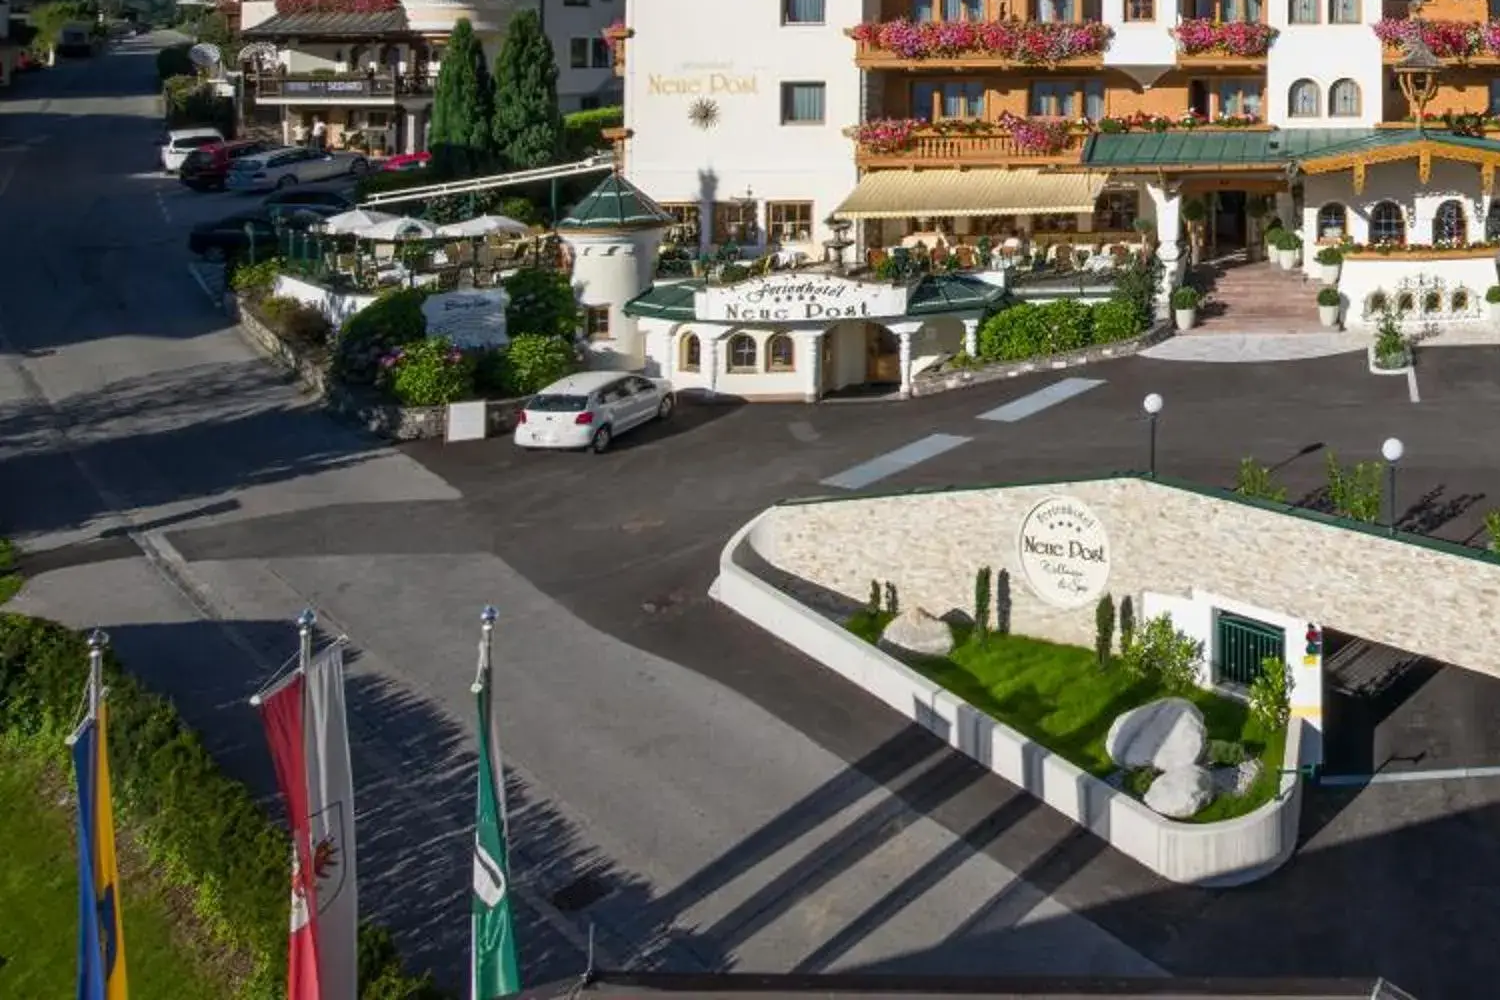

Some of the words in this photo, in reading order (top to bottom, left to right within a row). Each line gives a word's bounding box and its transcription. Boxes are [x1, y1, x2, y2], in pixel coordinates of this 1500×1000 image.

[726, 303, 789, 319] Neue
[805, 301, 870, 319] Post
[1024, 535, 1064, 557] Neue
[1069, 540, 1106, 563] Post
